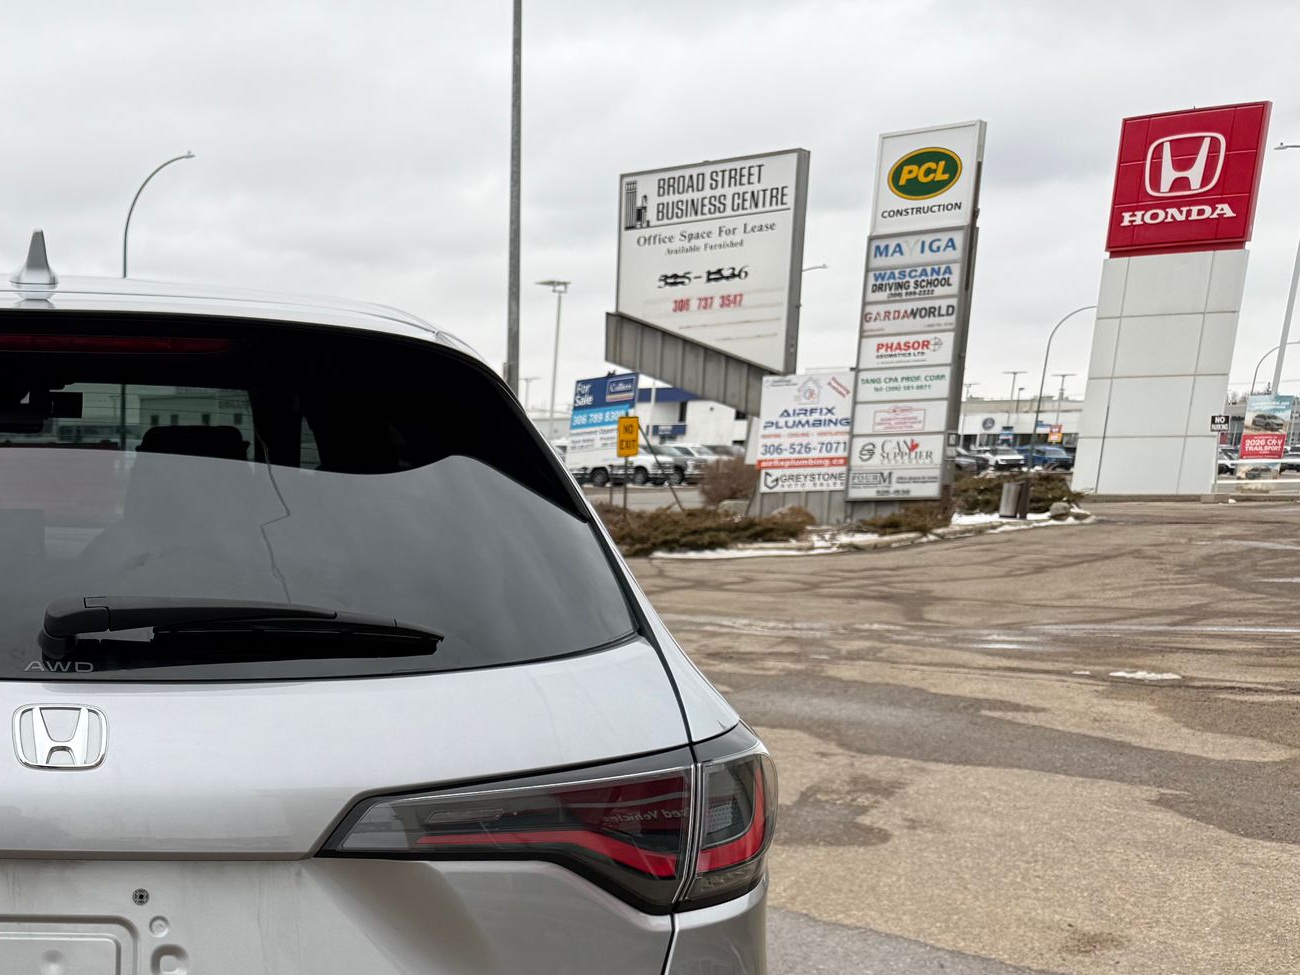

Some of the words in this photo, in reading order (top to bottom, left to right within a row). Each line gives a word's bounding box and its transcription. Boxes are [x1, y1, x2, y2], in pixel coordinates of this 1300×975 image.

[898, 160, 950, 186] PCL
[657, 172, 706, 198] BROAD
[709, 164, 765, 191] STREET
[656, 191, 727, 222] BUSINESS
[731, 186, 789, 212] CENTRE
[881, 202, 962, 219] CONSTRUCTION
[1120, 203, 1236, 227] HONDA
[636, 233, 675, 248] Office
[678, 229, 714, 244] Space
[717, 225, 738, 238] For
[743, 221, 777, 235] Lease
[873, 265, 953, 283] WASCANA
[871, 280, 911, 294] DRIVING
[913, 277, 953, 290] SCHOOL
[697, 295, 714, 311] 737
[863, 304, 956, 324] GARDAWORLD
[875, 339, 931, 353] PHASOR
[576, 382, 592, 395] For
[575, 395, 594, 407] Sale
[779, 406, 836, 418] AIRFIX
[763, 417, 852, 430] PLUMBING
[1214, 416, 1226, 424] NO
[623, 424, 634, 434] NO
[620, 439, 637, 451] EXIT
[761, 441, 847, 456] 306-526-7071
[1245, 439, 1266, 447] 2026
[779, 472, 846, 484] GREYSTONE
[24, 660, 94, 673] AWD
